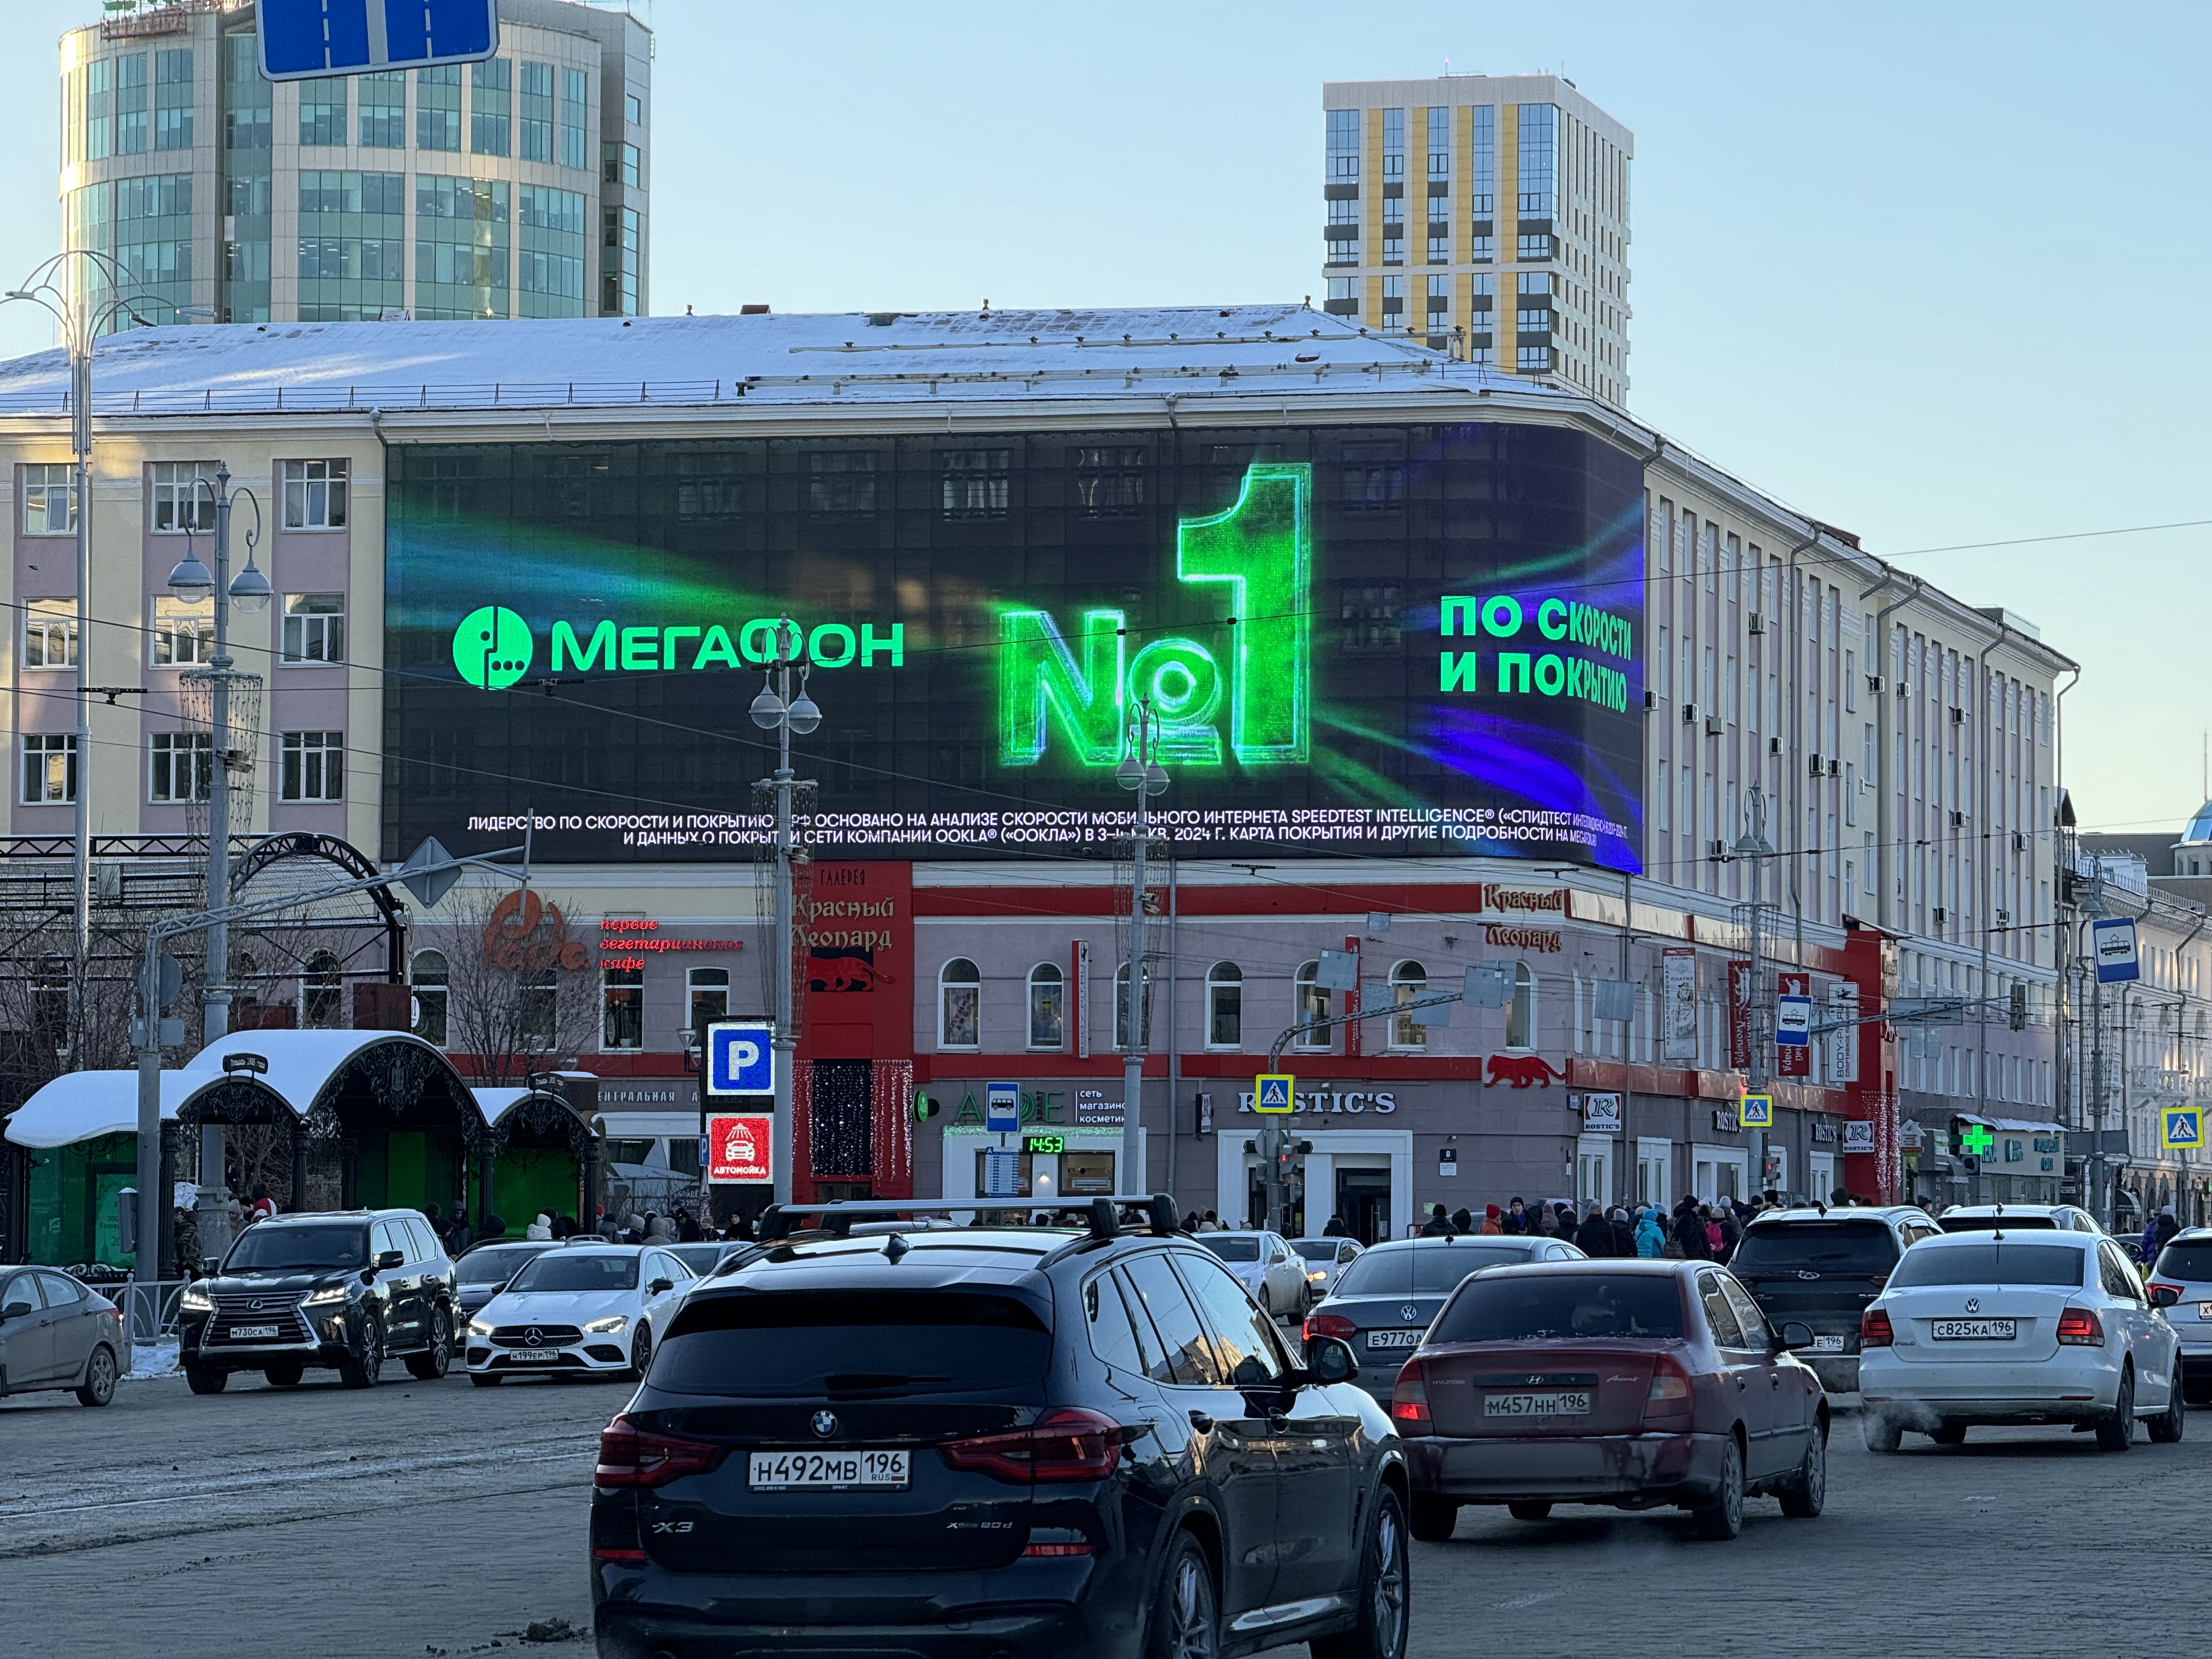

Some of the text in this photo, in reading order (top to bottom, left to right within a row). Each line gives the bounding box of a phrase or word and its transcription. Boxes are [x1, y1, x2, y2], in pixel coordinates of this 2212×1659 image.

[1441, 595, 1632, 661] ПО СКОРОСТИ
[1441, 652, 1628, 713] И ПОКРЫТИЮ
[560, 816, 582, 829] ПО
[585, 815, 668, 829] СКОРОСТИ
[673, 815, 682, 828] И
[687, 815, 774, 828] ПОКРЫТИЮ
[815, 813, 904, 827] ОСНОВАНО
[907, 813, 927, 826] НА
[931, 812, 998, 827] АНАЛИЗЕ
[1002, 812, 1087, 826] СКОРОСТИ
[1204, 810, 1288, 824] ИНТЕРНЕТА
[1291, 809, 1373, 823] SPEEDTEST
[624, 831, 634, 845] И
[637, 831, 698, 847] ДАННЫХ
[702, 831, 715, 844] О
[719, 831, 800, 844] ПОКРЫТИ
[804, 830, 843, 844] СЕТИ
[847, 829, 932, 843] КОМПАНИИ
[1085, 828, 1094, 842] В
[1175, 827, 1211, 841] 2024
[1215, 827, 1226, 840] Г.
[1230, 826, 1274, 840] КАРТА
[1279, 825, 1363, 840] ПОКРЫТИЯ
[1367, 825, 1377, 839] И
[1381, 825, 1437, 840] ДРУГИЕ
[1442, 825, 1553, 841] ПОДРОБНОСТИ
[1556, 828, 1569, 842] НА
[821, 869, 865, 885] ГАЛЕРЕЯ
[1484, 884, 1563, 913] Красный
[792, 895, 895, 923] Красный
[600, 919, 659, 934] первое
[792, 924, 893, 952] Леопард
[1485, 923, 1562, 953] Леопард
[600, 956, 646, 973] кафе
[597, 1091, 675, 1102] ЕНТРАЛЬНАЯ
[1238, 1092, 1396, 1113] RSTIC'S
[1029, 1137, 1063, 1153] 14:53
[714, 1165, 766, 1175] АВТОМОЙКА
[232, 1328, 263, 1337] М730СА
[1937, 1321, 2011, 1336] С825КА 196
[1825, 1336, 1842, 1345] 196
[512, 1351, 543, 1360] Н199ЕР
[1487, 1394, 1585, 1414] М457НН 196
[758, 1453, 902, 1482] Н492МВ 196
[871, 1473, 890, 1481] RUS
[651, 1521, 694, 1533] X3
